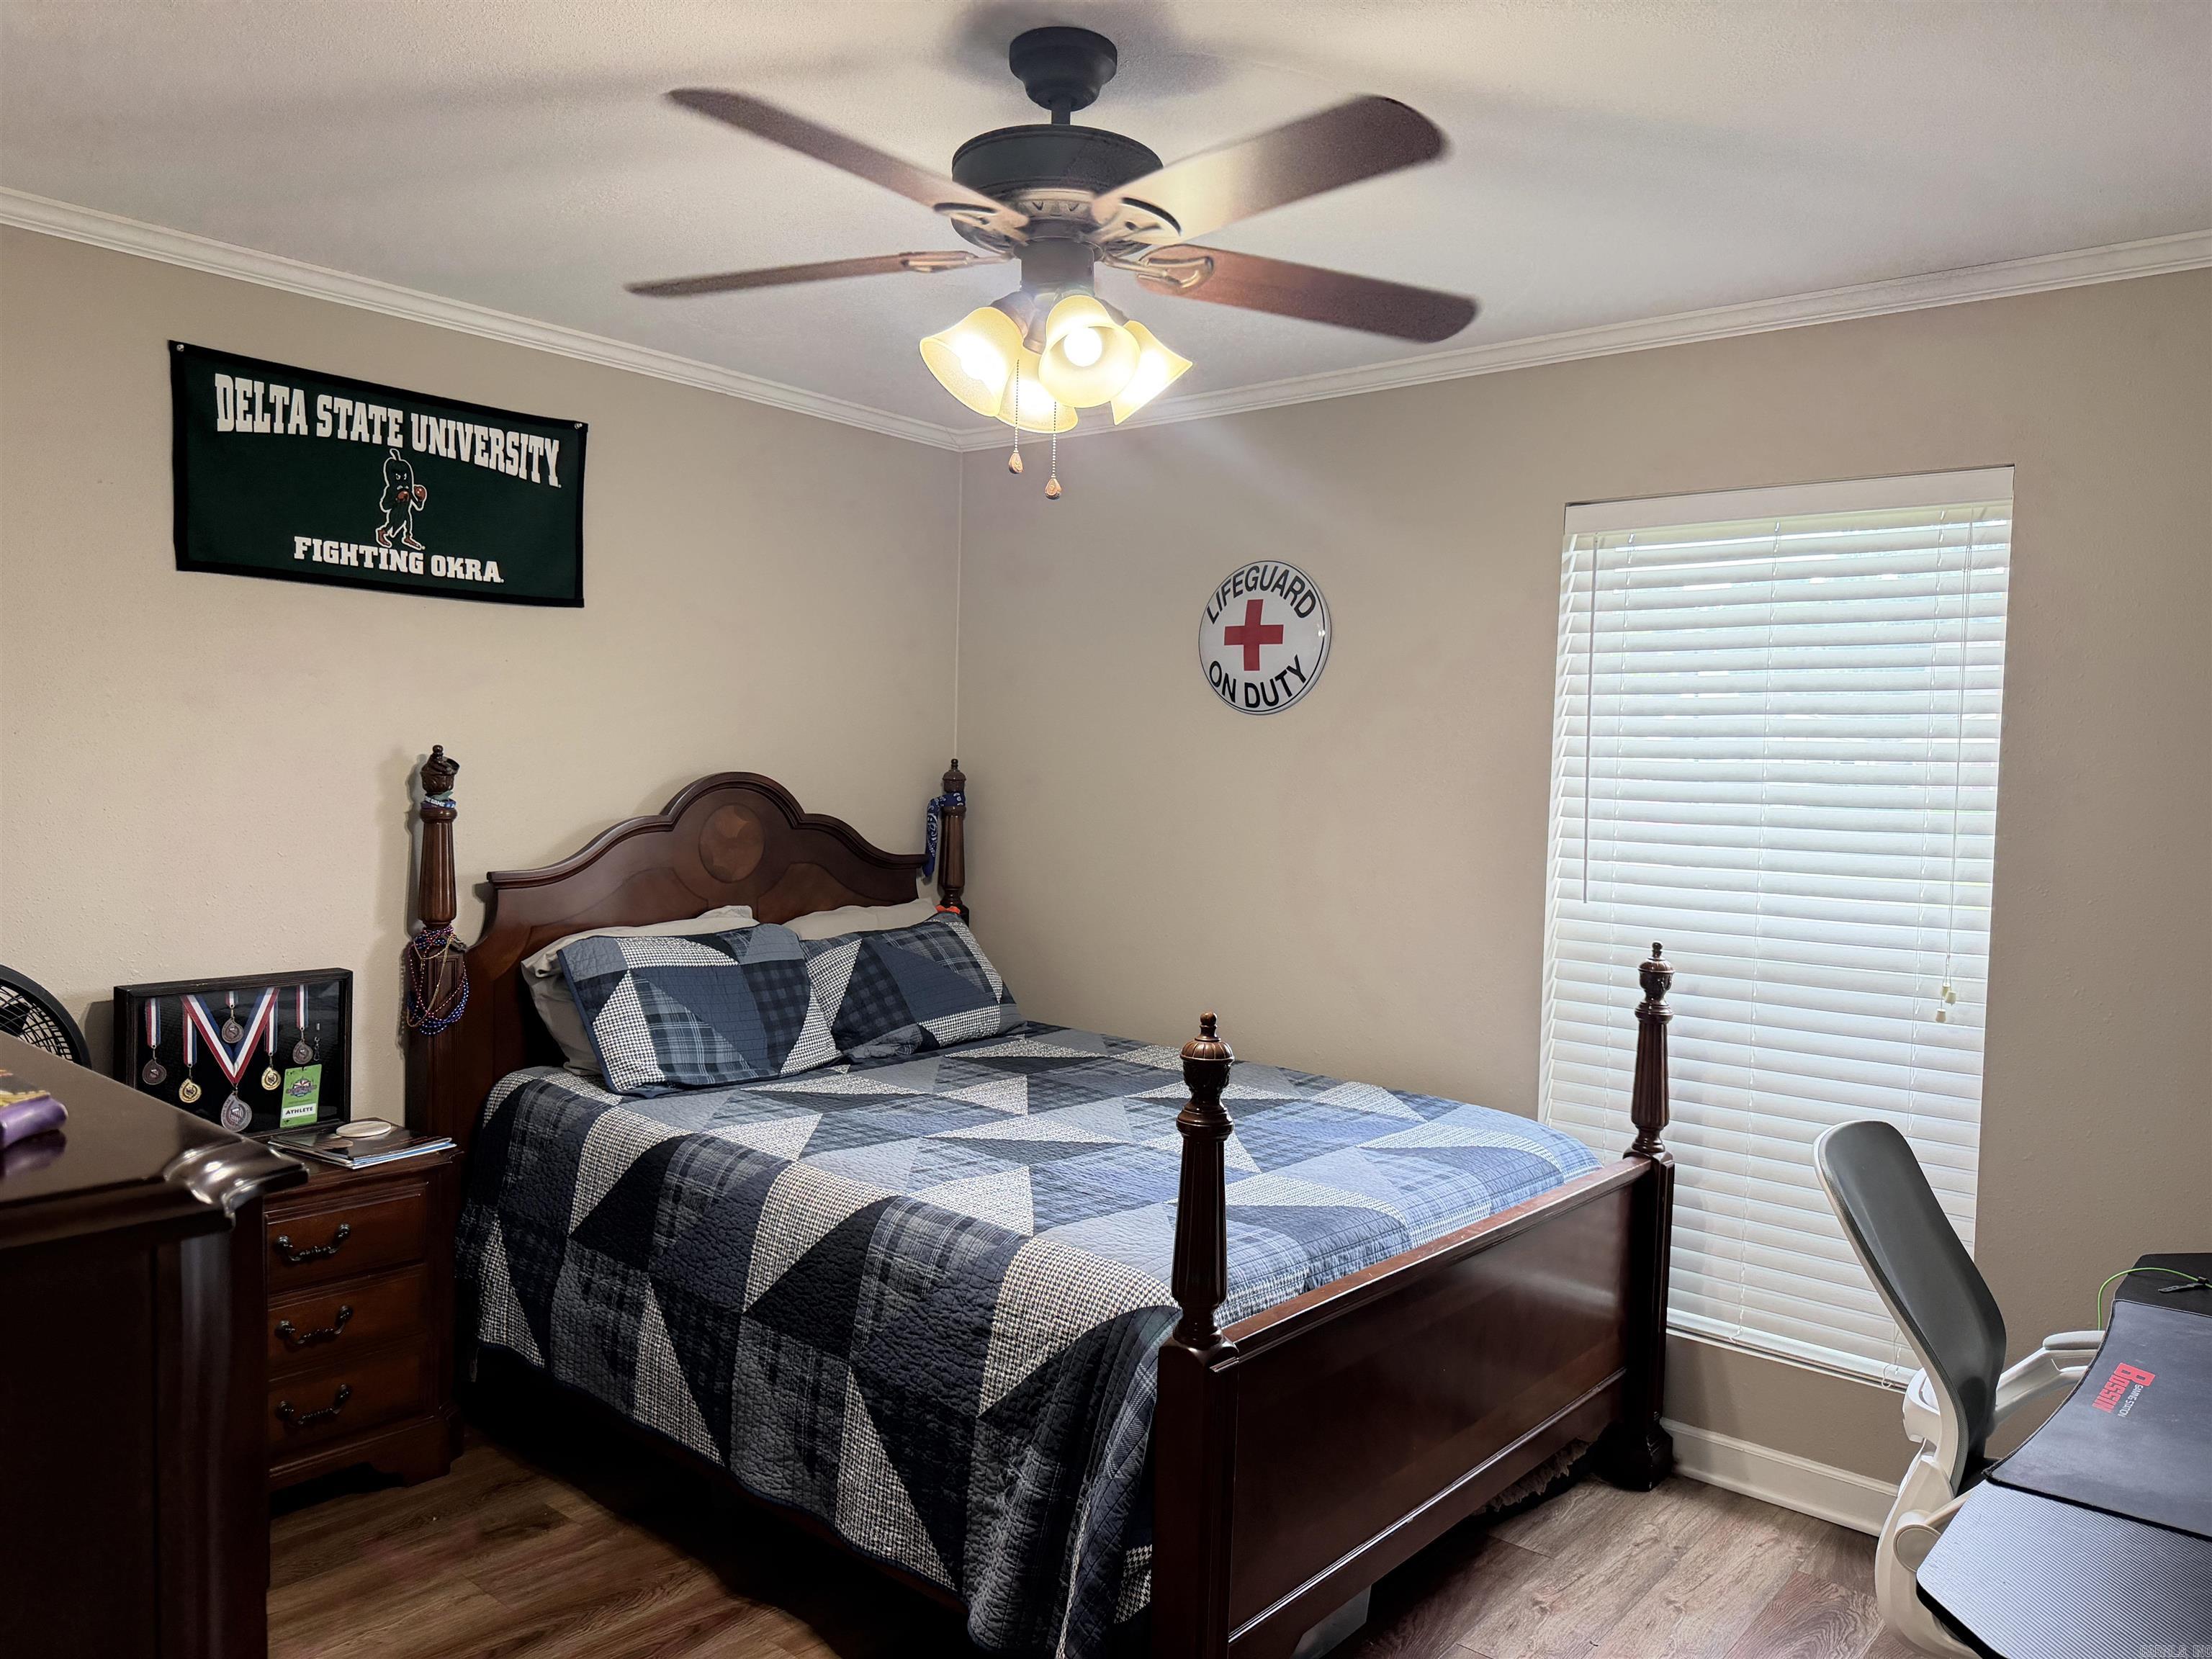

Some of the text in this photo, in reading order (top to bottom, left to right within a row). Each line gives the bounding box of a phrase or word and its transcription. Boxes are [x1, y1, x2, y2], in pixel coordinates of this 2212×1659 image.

[215, 374, 562, 488] DELTA STATE UNIVERSITY
[294, 536, 505, 584] FIGHTING OKRA
[1206, 565, 1316, 624] LIFEGUARD
[1209, 654, 1306, 708] ON DUTY
